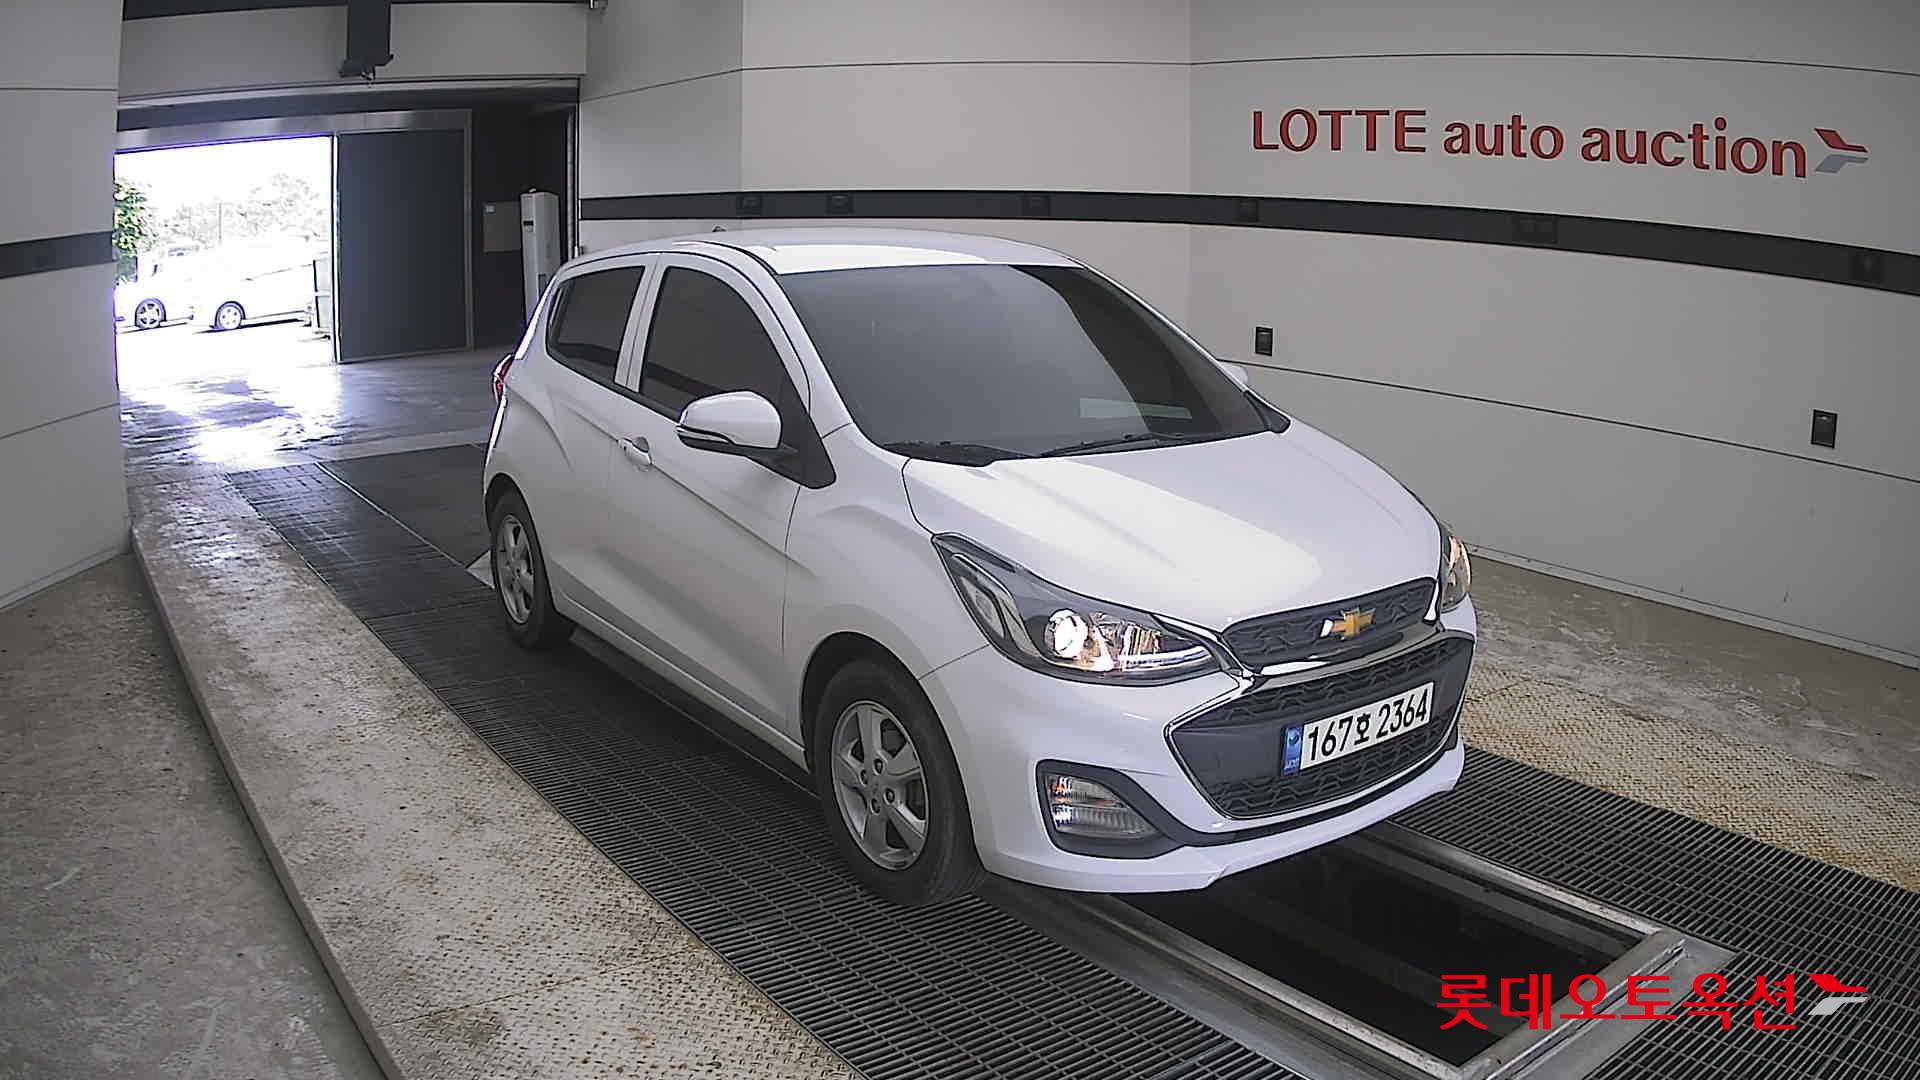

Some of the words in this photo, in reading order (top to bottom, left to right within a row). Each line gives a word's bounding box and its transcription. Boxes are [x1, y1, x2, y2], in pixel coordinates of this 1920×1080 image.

[1253, 109, 1426, 152] LOTTE
[1443, 115, 1564, 159] auto
[1580, 117, 1807, 178] auction
[1308, 713, 1371, 761] 167호
[1376, 688, 1429, 739] 2364
